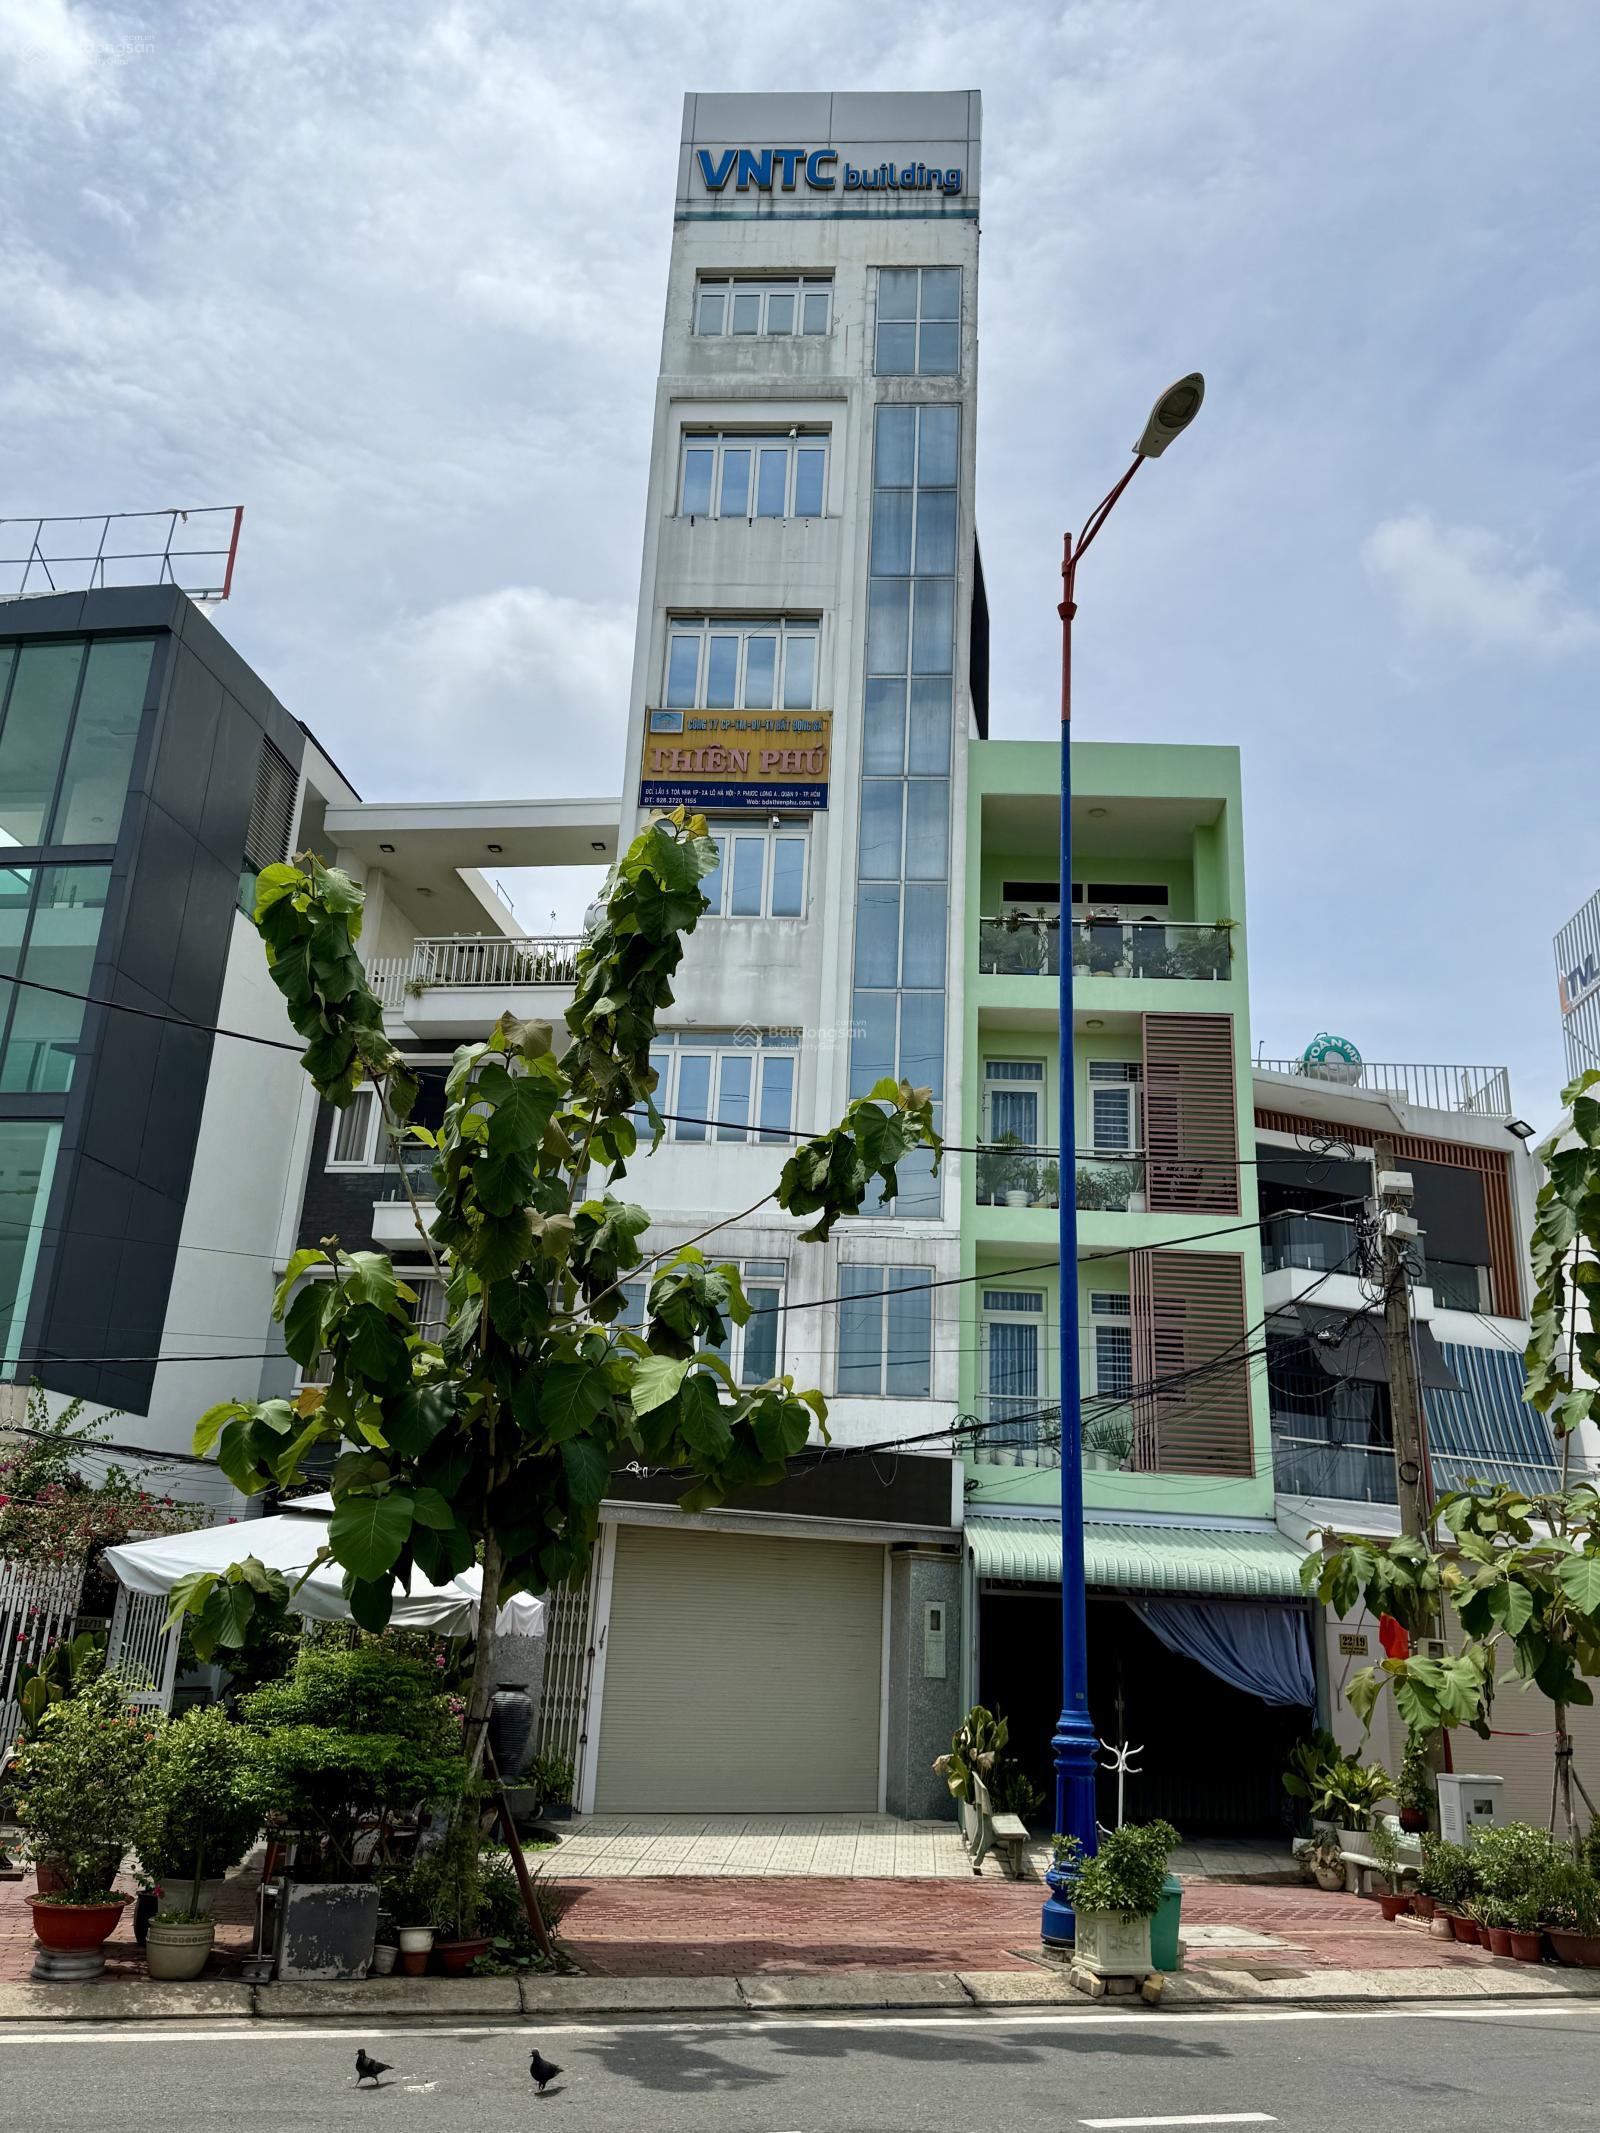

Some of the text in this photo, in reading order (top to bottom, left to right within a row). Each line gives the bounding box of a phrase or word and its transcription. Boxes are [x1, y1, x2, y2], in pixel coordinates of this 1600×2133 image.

[696, 149, 963, 196] VNTC building
[652, 743, 826, 775] THIÊN PHÚ
